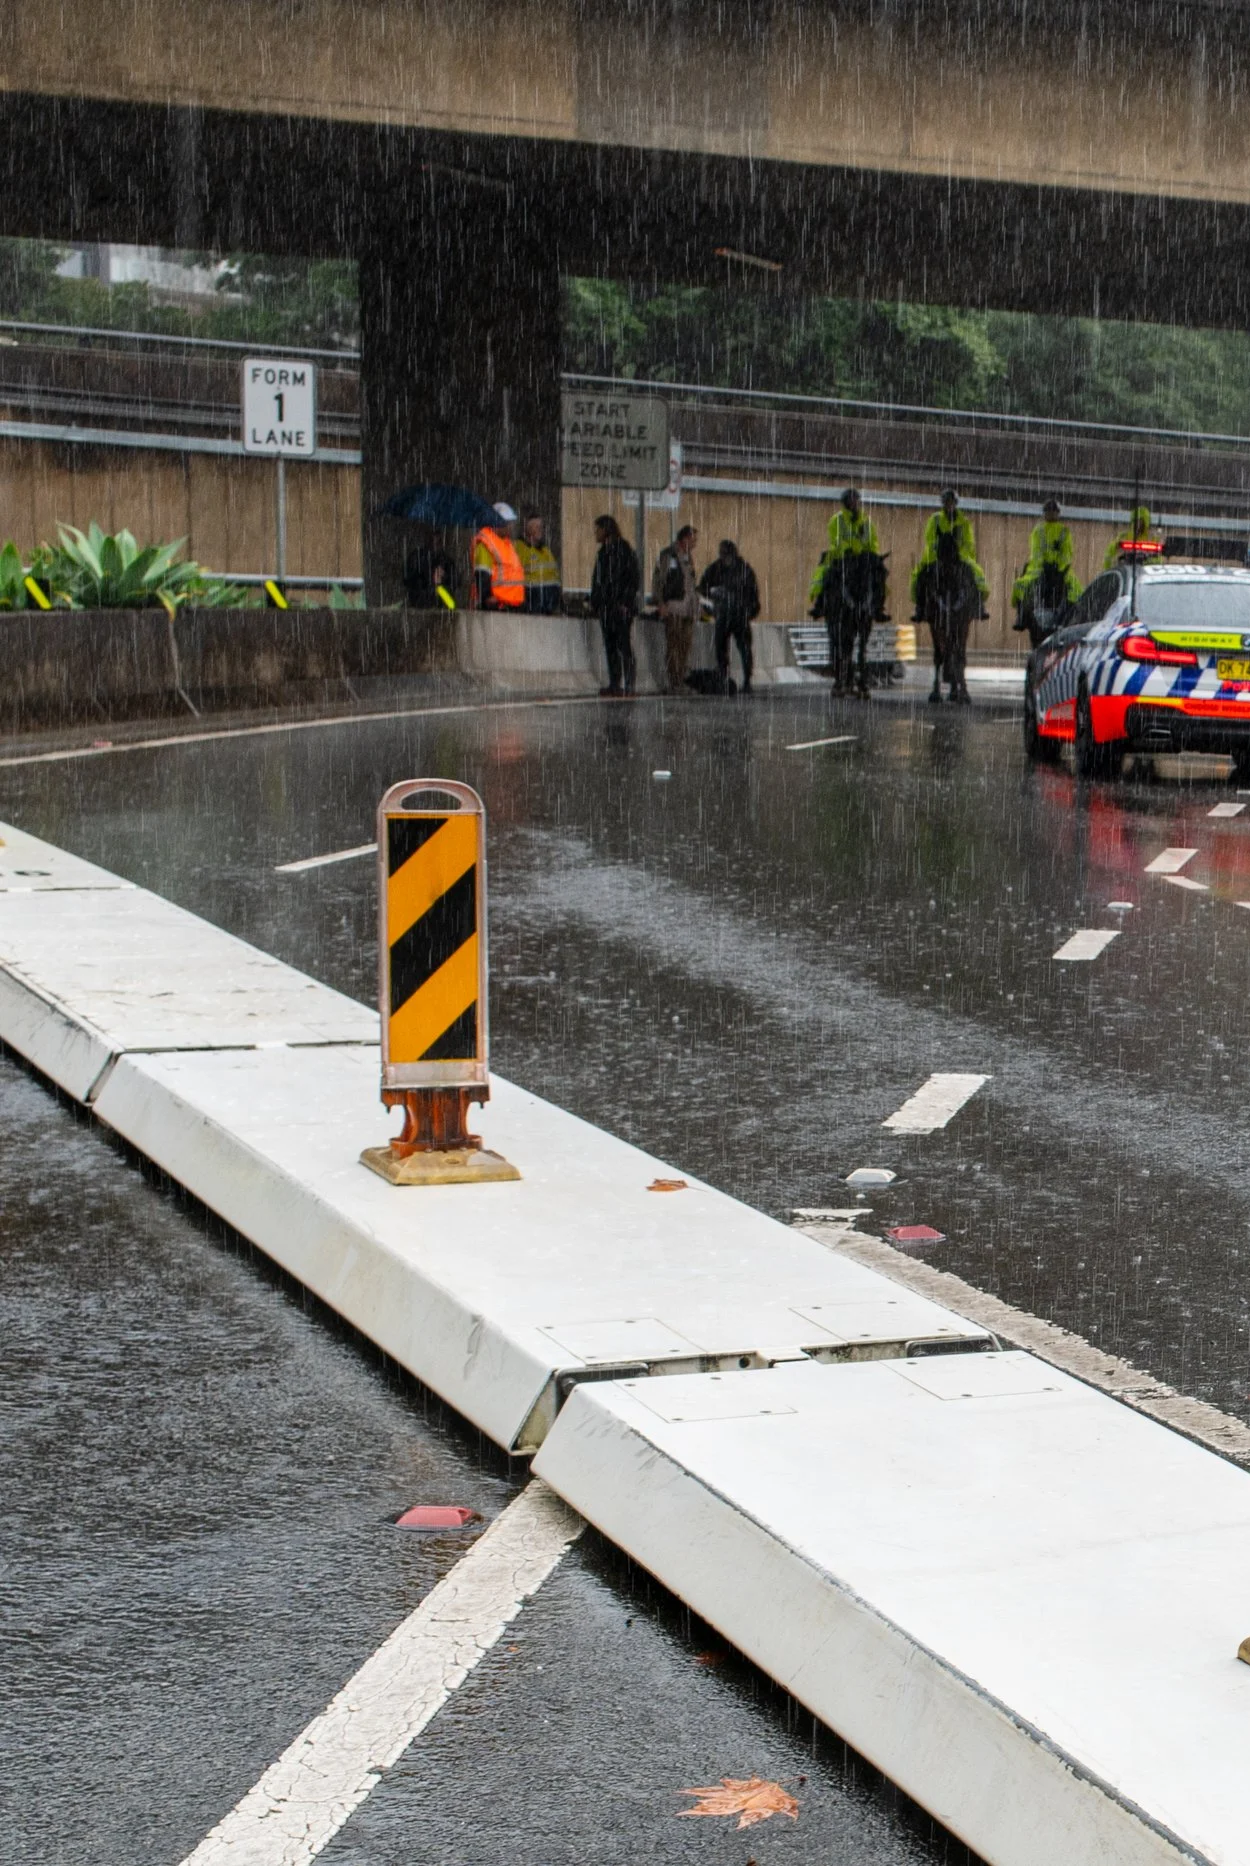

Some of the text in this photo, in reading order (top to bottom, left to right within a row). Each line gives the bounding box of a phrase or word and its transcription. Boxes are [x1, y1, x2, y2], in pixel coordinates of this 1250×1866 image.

[251, 367, 306, 387] FORM
[273, 391, 285, 423] 1
[573, 401, 630, 417] START
[251, 427, 305, 447] LANE
[612, 444, 658, 460] LIMIT
[580, 462, 627, 479] ZONE
[1180, 635, 1234, 644] HIGHWAY
